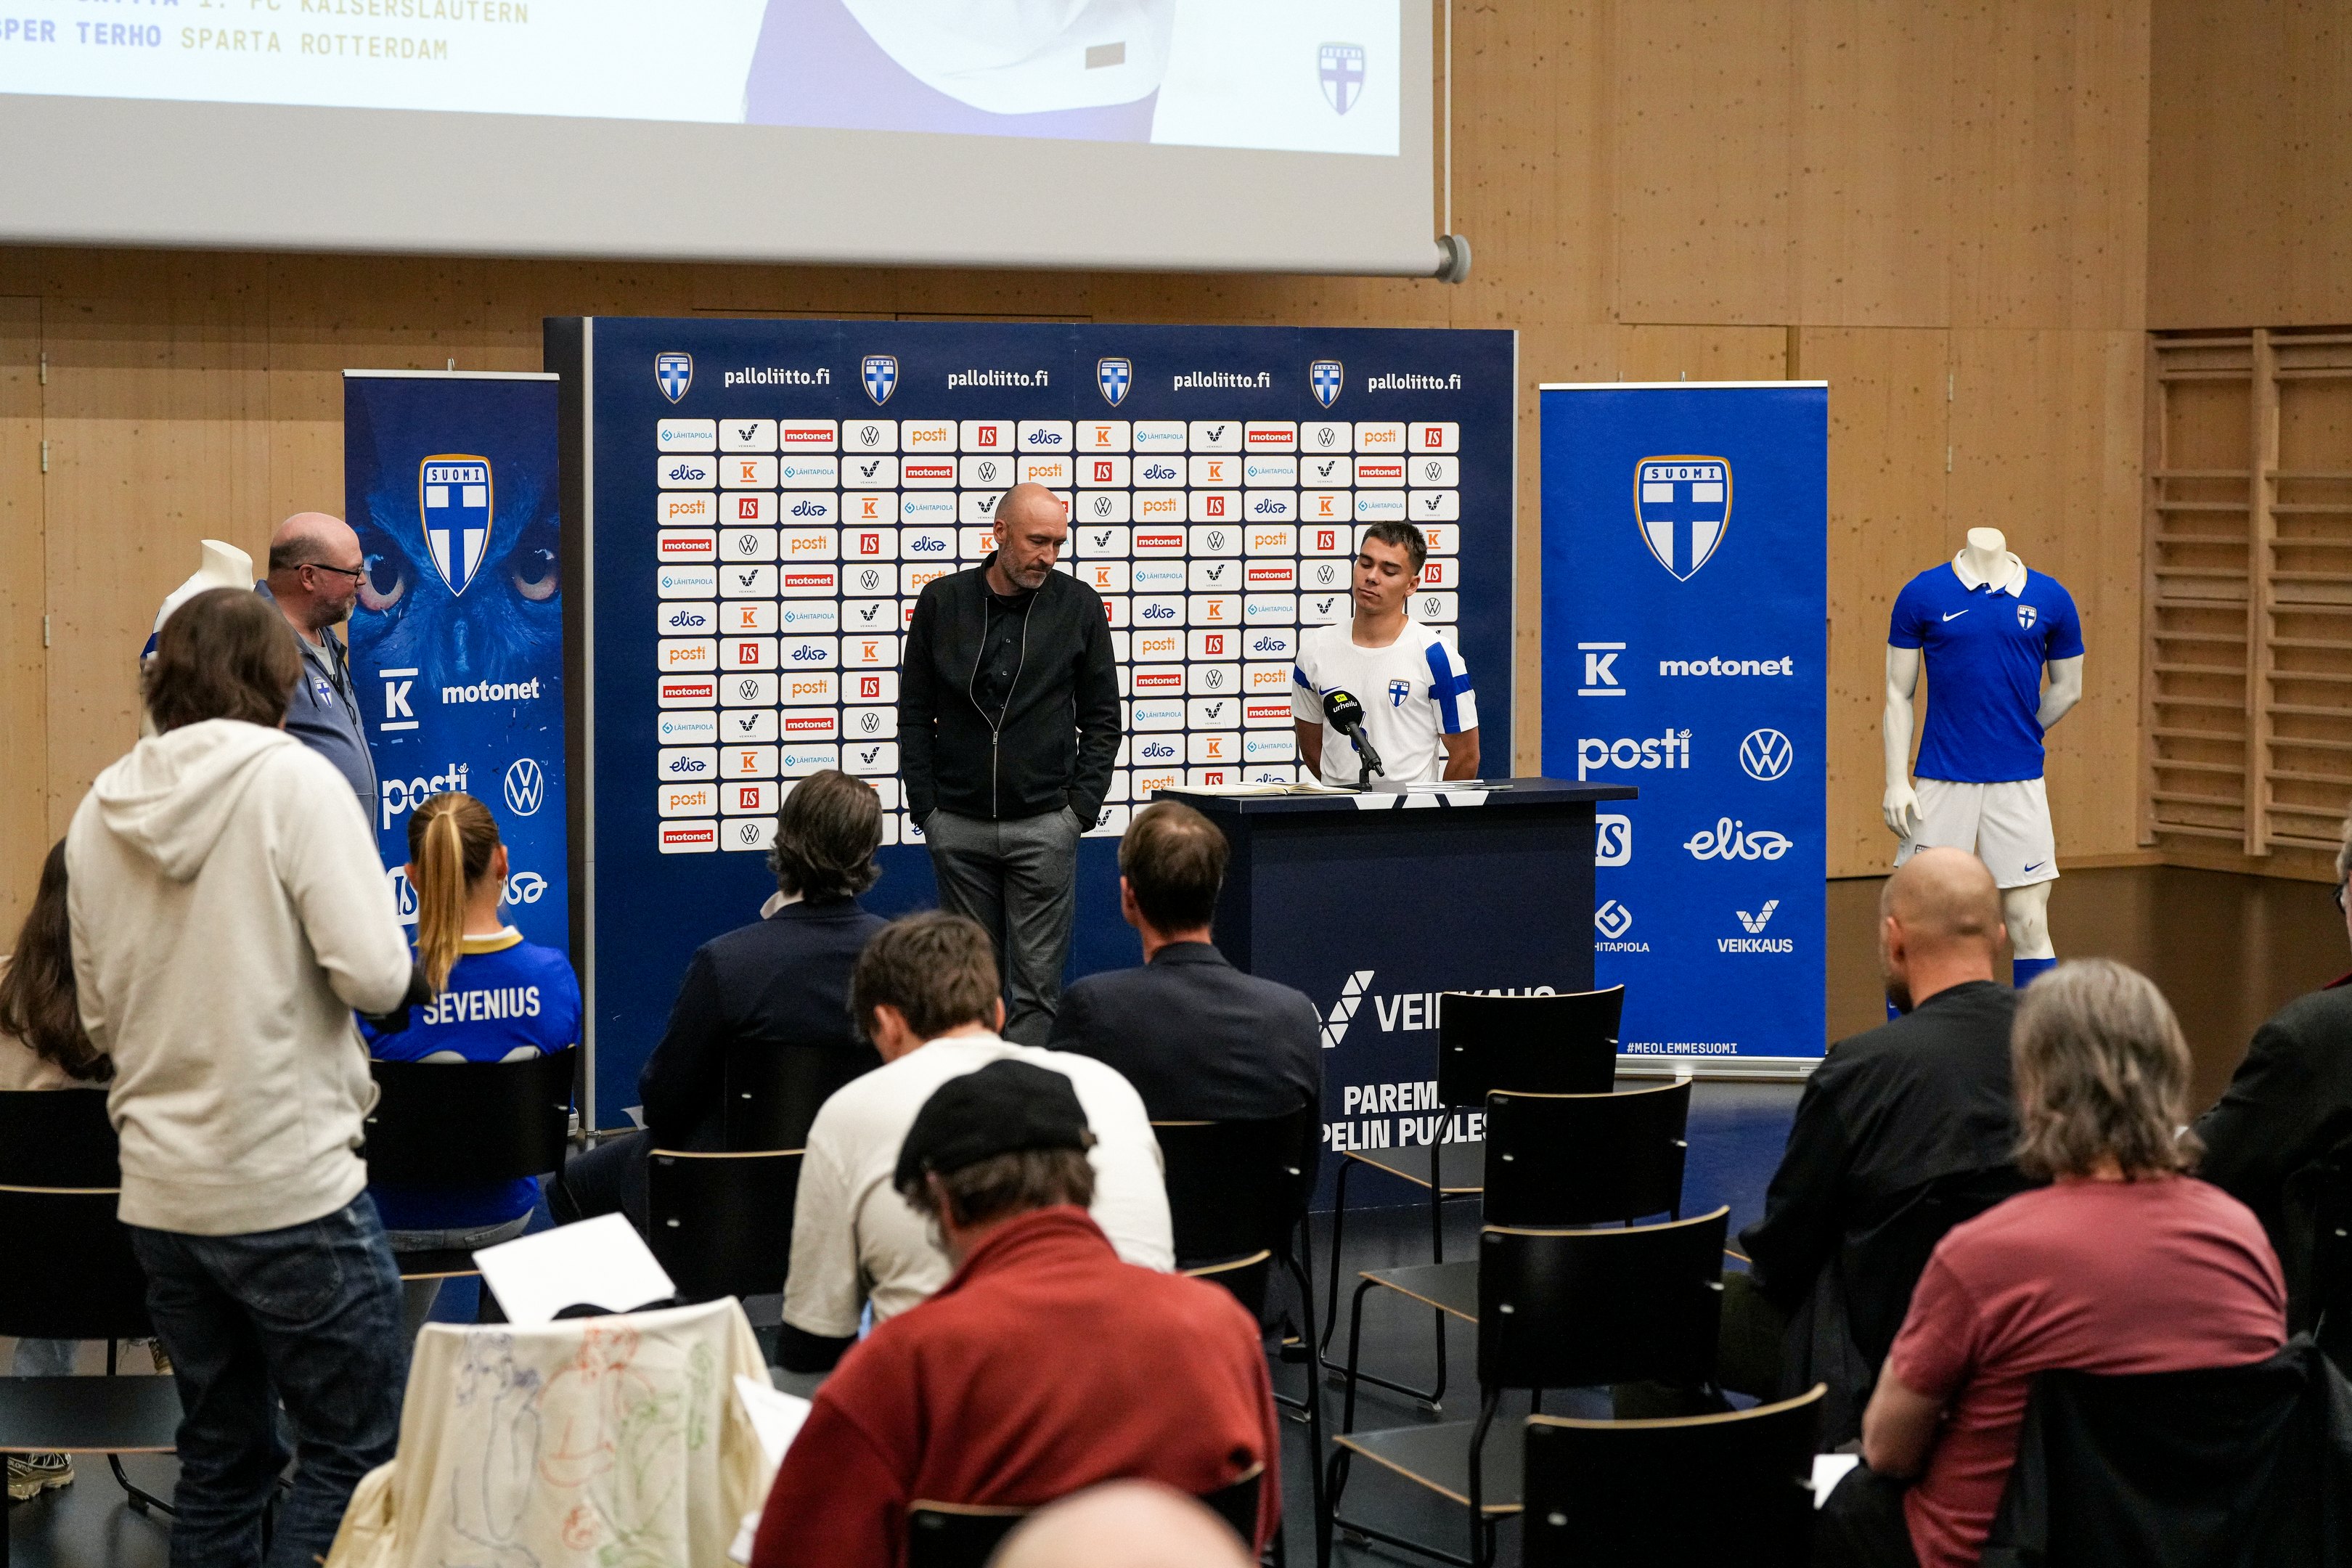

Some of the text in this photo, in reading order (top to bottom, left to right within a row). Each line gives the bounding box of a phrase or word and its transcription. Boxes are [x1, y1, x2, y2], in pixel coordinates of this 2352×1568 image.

[301, 0, 528, 23] KAISERSLAUTERN
[0, 18, 448, 60] PER TERHO SPARTA ROTTERDAM
[724, 367, 830, 388] palloliitto.fi
[947, 369, 1049, 390] palloliitto.fi
[1174, 371, 1270, 391] palloliitto.fi
[1368, 373, 1461, 392] palloliitto.fi
[912, 428, 947, 446] posti
[1028, 429, 1062, 444] elisa
[1365, 430, 1395, 446] posti
[432, 468, 481, 481] SUOMI
[669, 465, 706, 480] elisa
[1029, 463, 1062, 481] posti
[1143, 465, 1176, 479] elisa
[1651, 467, 1715, 479] SUOMI
[669, 500, 705, 518] posti
[791, 501, 827, 515] elisa
[1143, 499, 1176, 516] posti
[1254, 499, 1287, 513] elisa
[792, 536, 827, 554] posti
[911, 536, 946, 551] elisa
[1255, 533, 1287, 550] posti
[669, 611, 706, 626] elisa
[1143, 604, 1175, 618] elisa
[1143, 637, 1175, 655] posti
[1253, 637, 1286, 650] elisa
[670, 646, 706, 664] posti
[791, 645, 827, 661] elisa
[1659, 655, 1794, 677] motonet
[1254, 669, 1286, 687] posti
[442, 677, 540, 704] motonet
[792, 679, 828, 698] posti
[1333, 700, 1357, 713] urheilu
[1142, 743, 1175, 757] elisa
[1577, 728, 1693, 782] posti
[669, 756, 706, 772] elisa
[1142, 776, 1175, 796] posti
[670, 791, 706, 810] posti
[1683, 817, 1794, 861] elisa
[1594, 942, 1650, 952] HITAPIOLA
[1717, 938, 1793, 954] VEIKKAUS
[423, 986, 541, 1025] SEVENIUS
[1627, 1042, 1738, 1054] #MEOLEMMESUOMI
[1344, 1080, 1446, 1116] PAREM
